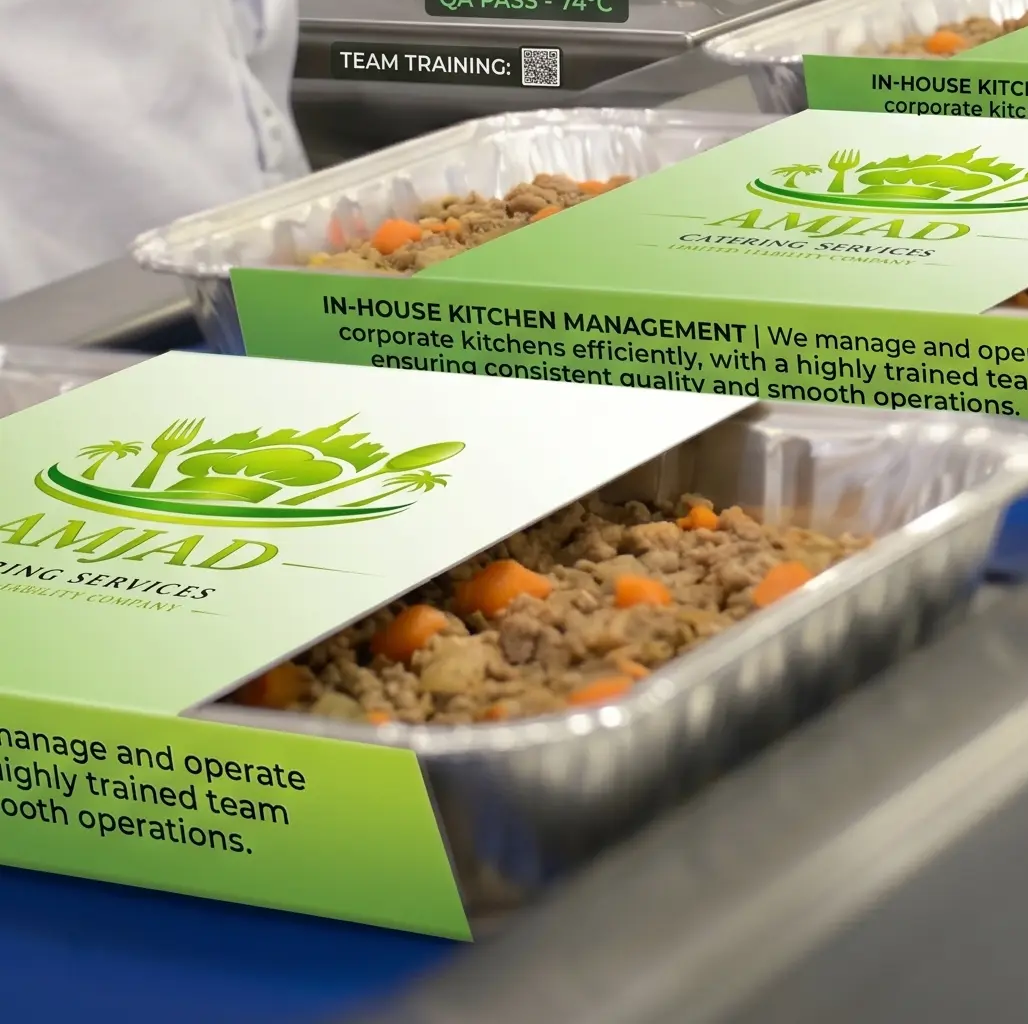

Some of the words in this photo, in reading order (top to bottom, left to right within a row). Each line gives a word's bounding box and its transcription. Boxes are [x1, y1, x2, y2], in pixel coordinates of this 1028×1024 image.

[340, 51, 399, 71] TEAM
[404, 54, 511, 76] TRAINING:
[871, 73, 972, 95] IN-HOUSE
[884, 100, 983, 117] corporate
[703, 208, 971, 242] AMJAD
[679, 233, 809, 250] CATERING
[814, 242, 936, 258] SERVICES
[322, 295, 442, 323] IN-HOUSE
[449, 304, 556, 331] KITCHEN
[564, 312, 747, 343] MANAGEMENT
[767, 325, 808, 348] We
[815, 332, 916, 359] manage
[923, 338, 970, 359] and
[339, 325, 454, 349] corporate
[461, 330, 566, 358] kitchens
[572, 339, 704, 371] efficiently,
[709, 350, 767, 373] with
[774, 356, 789, 374] a
[797, 354, 877, 384] highly
[884, 362, 979, 388] trained
[371, 352, 477, 376] ensuring
[484, 359, 613, 387] consistent
[619, 370, 705, 395] quality
[713, 377, 760, 398] and
[767, 381, 865, 406] smooth
[873, 391, 1021, 417] operations.
[0, 512, 279, 571] AMJAD
[67, 572, 216, 601] SERVICES
[86, 593, 182, 612] COMPANY
[117, 744, 174, 772] and
[184, 754, 306, 791] operate
[0, 756, 77, 798] ighly
[86, 770, 198, 811] trained
[206, 789, 289, 825] team
[0, 797, 69, 826] ooth
[78, 808, 253, 855] operations.
